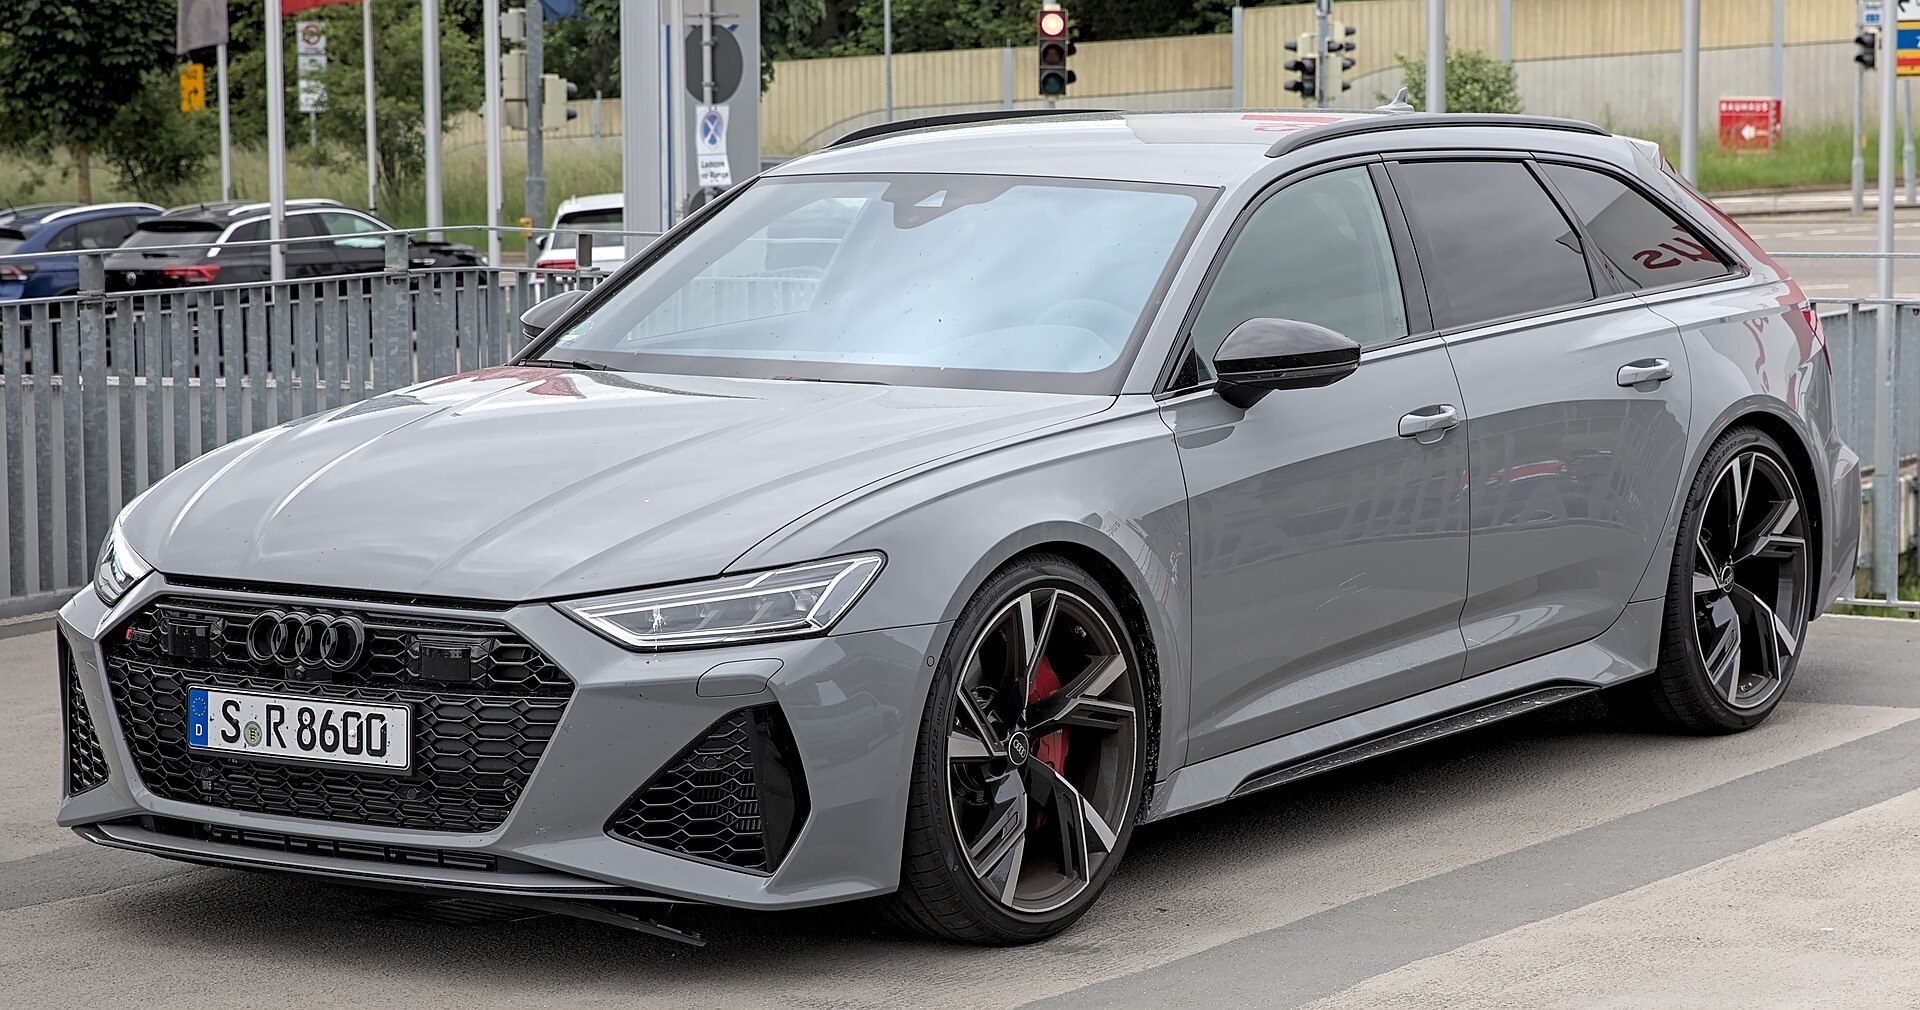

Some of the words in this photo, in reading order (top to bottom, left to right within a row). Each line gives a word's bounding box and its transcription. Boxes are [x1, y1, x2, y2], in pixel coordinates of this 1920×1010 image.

[1720, 101, 1769, 112] BAUHAUS
[195, 723, 203, 736] D
[220, 699, 241, 744] S
[265, 703, 287, 749] R
[296, 706, 388, 757] 8600
